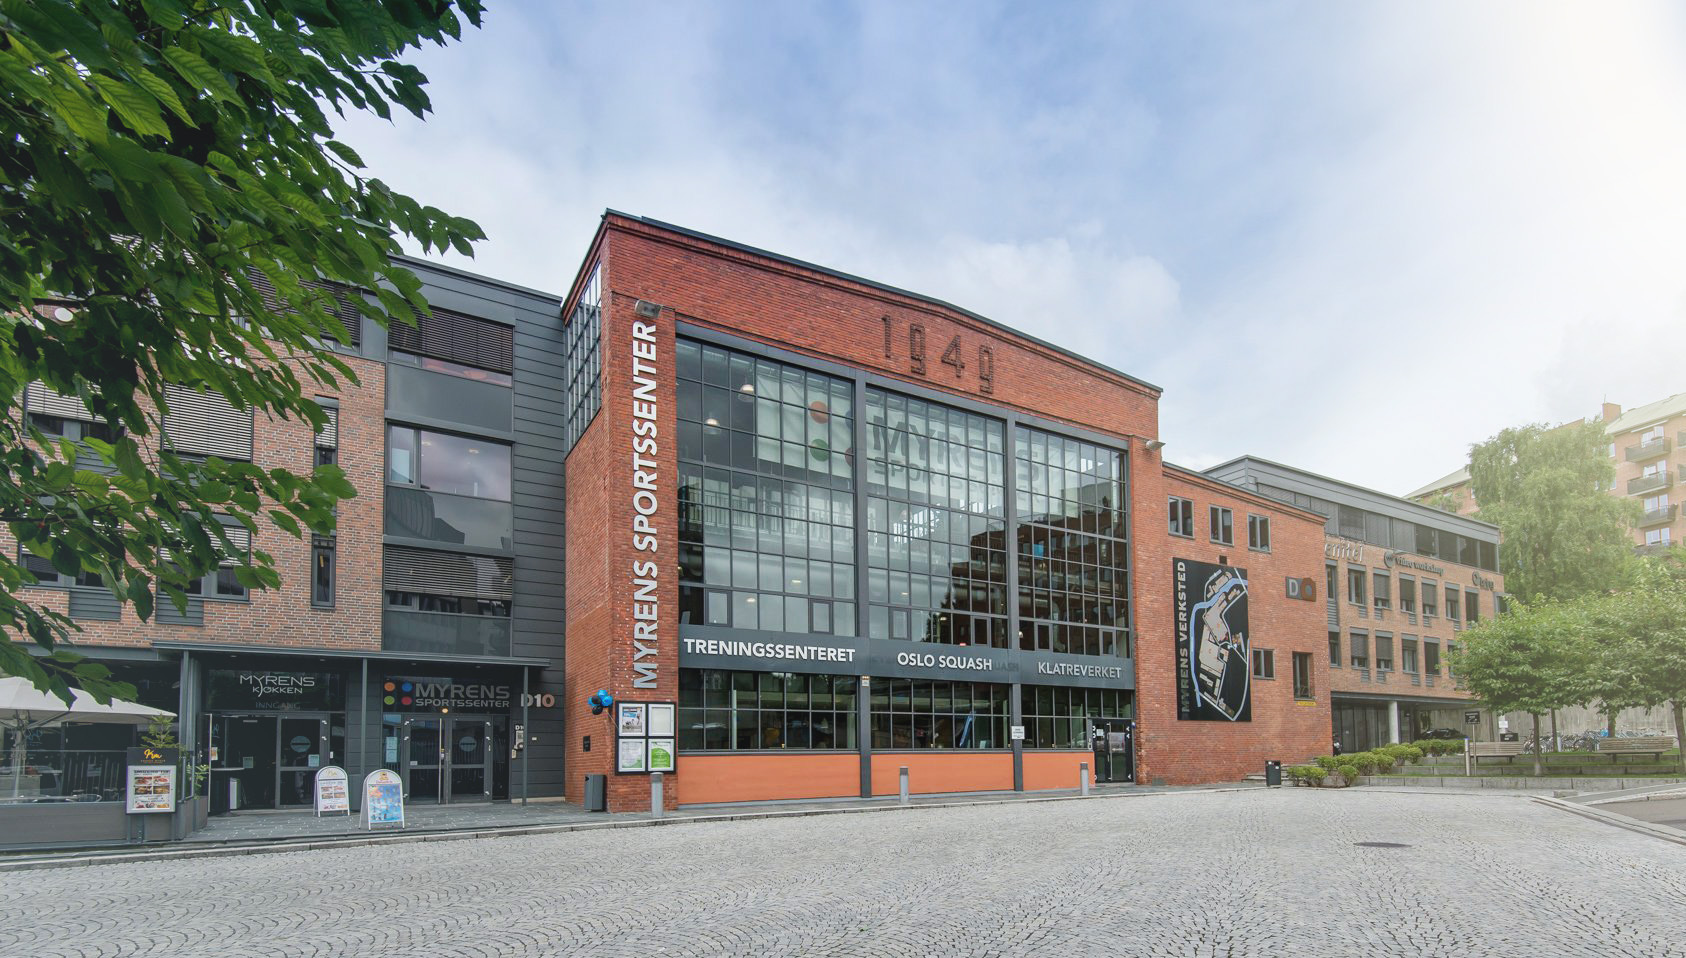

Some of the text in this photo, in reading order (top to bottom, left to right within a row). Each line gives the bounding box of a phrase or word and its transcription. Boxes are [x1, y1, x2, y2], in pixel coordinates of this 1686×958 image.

[872, 415, 1040, 482] MYRENS
[633, 320, 658, 689] MYRENS SPORTSSENTER
[1177, 561, 1190, 712] MYRENS VERKSTED
[684, 638, 856, 662] TRENINGSSENTERET
[897, 652, 992, 671] OSLO SQUASH
[1038, 661, 1122, 679] KLATREVERKET
[240, 674, 315, 697] MYRENS
[415, 683, 510, 699] MYRENS
[415, 698, 510, 708] SPORTSSENTER
